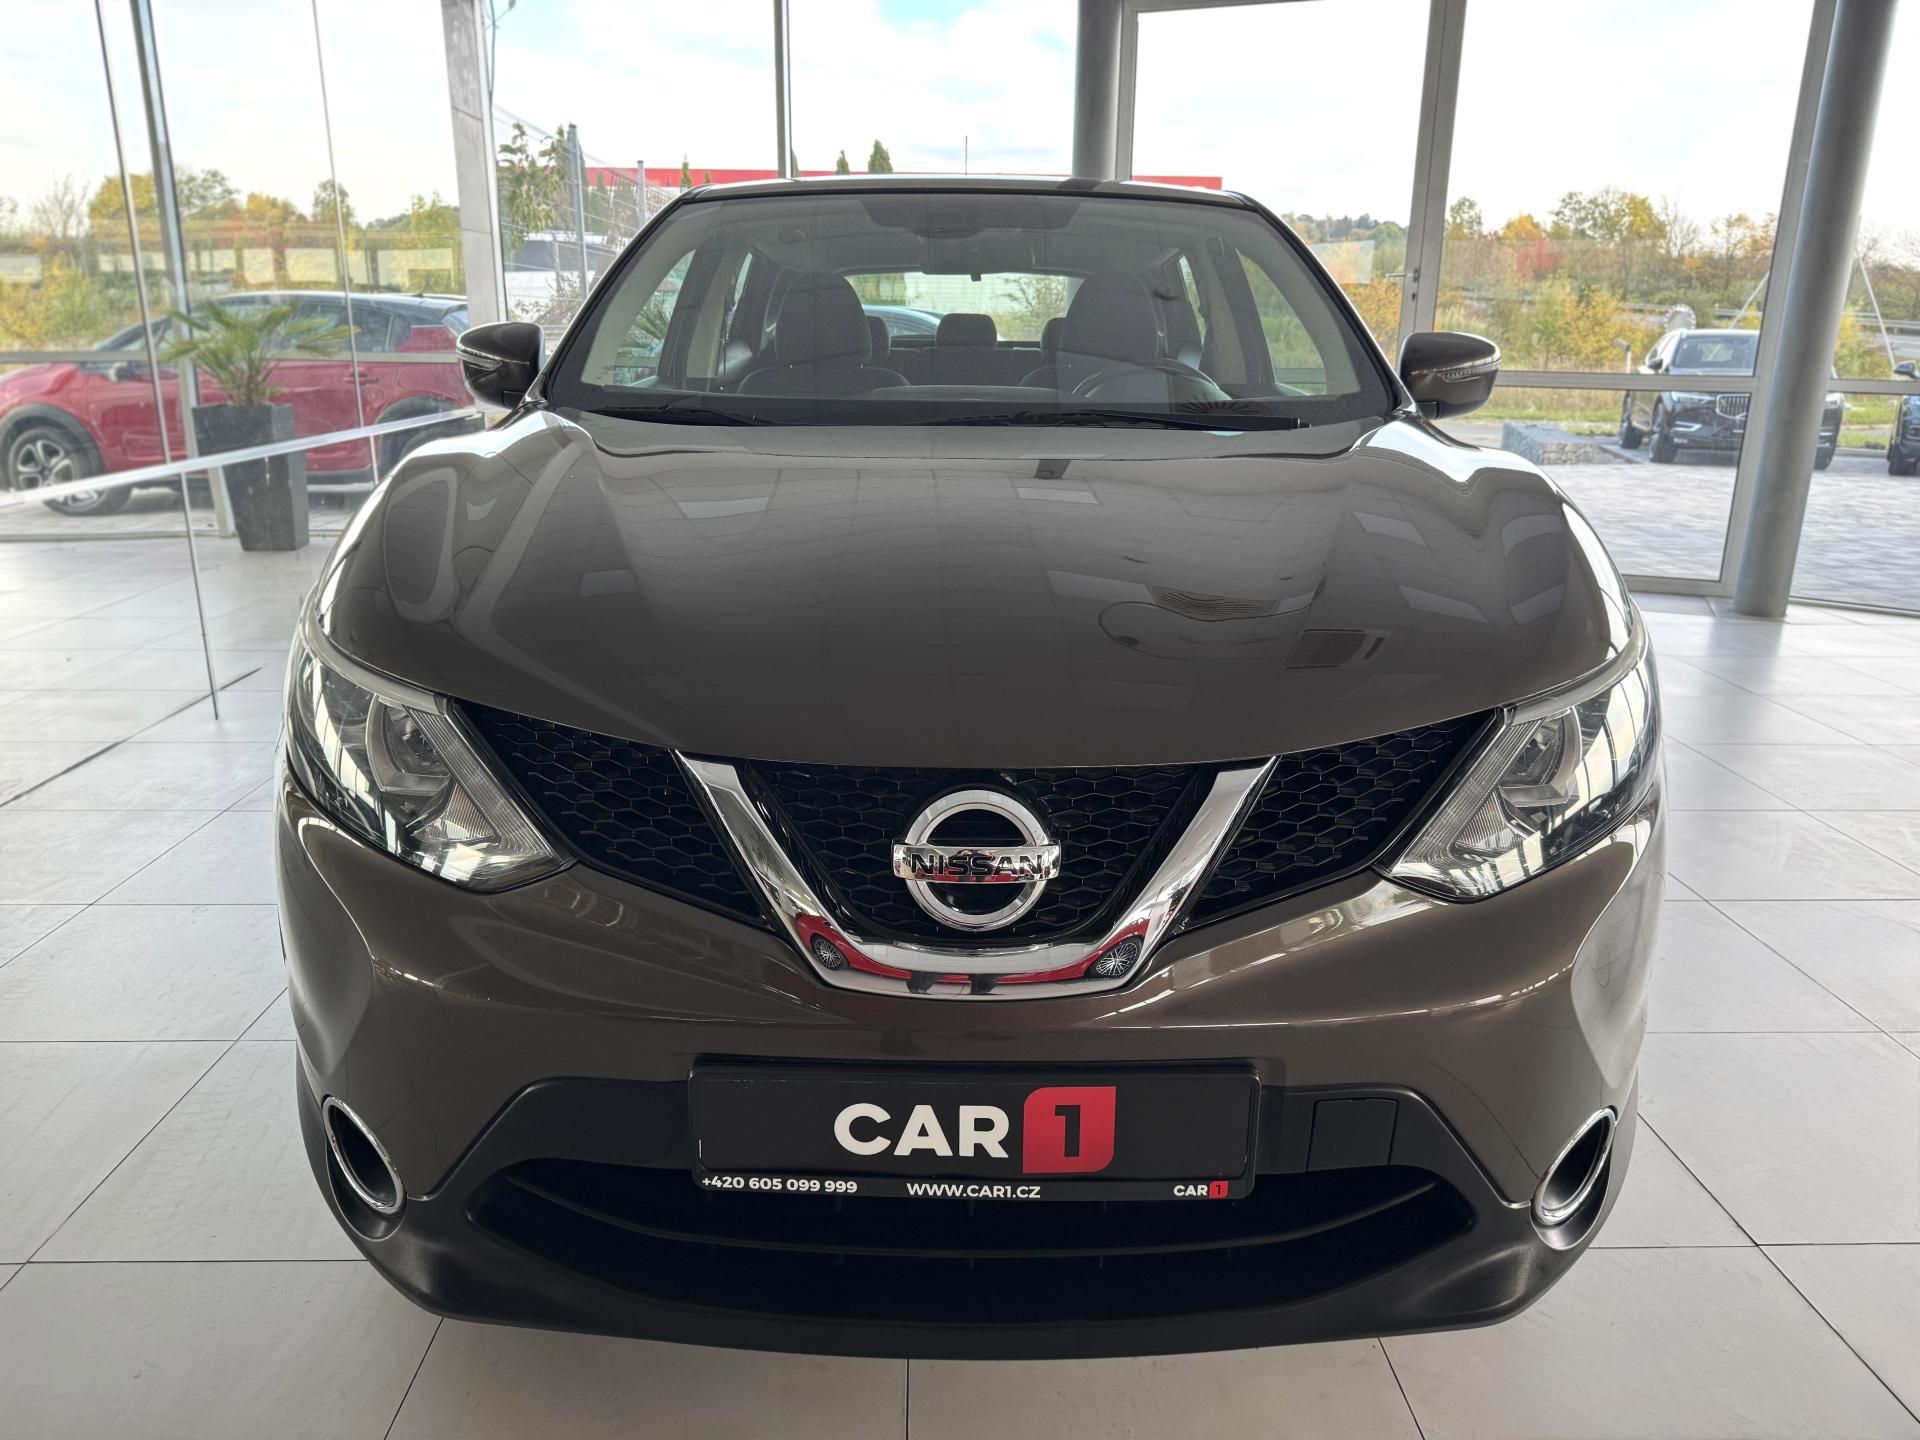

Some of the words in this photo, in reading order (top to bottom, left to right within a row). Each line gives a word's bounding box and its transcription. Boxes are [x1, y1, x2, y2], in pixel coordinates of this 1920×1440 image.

[911, 853, 1043, 876] NISSAN
[834, 1103, 1010, 1159] CAR
[1054, 1104, 1081, 1158] 1
[702, 1175, 745, 1189] +420
[749, 1177, 783, 1191] 605
[786, 1179, 821, 1192] 099
[824, 1180, 858, 1193] 999
[906, 1182, 1041, 1198] WWW.CAR1.CZ
[1173, 1184, 1208, 1197] CAR
